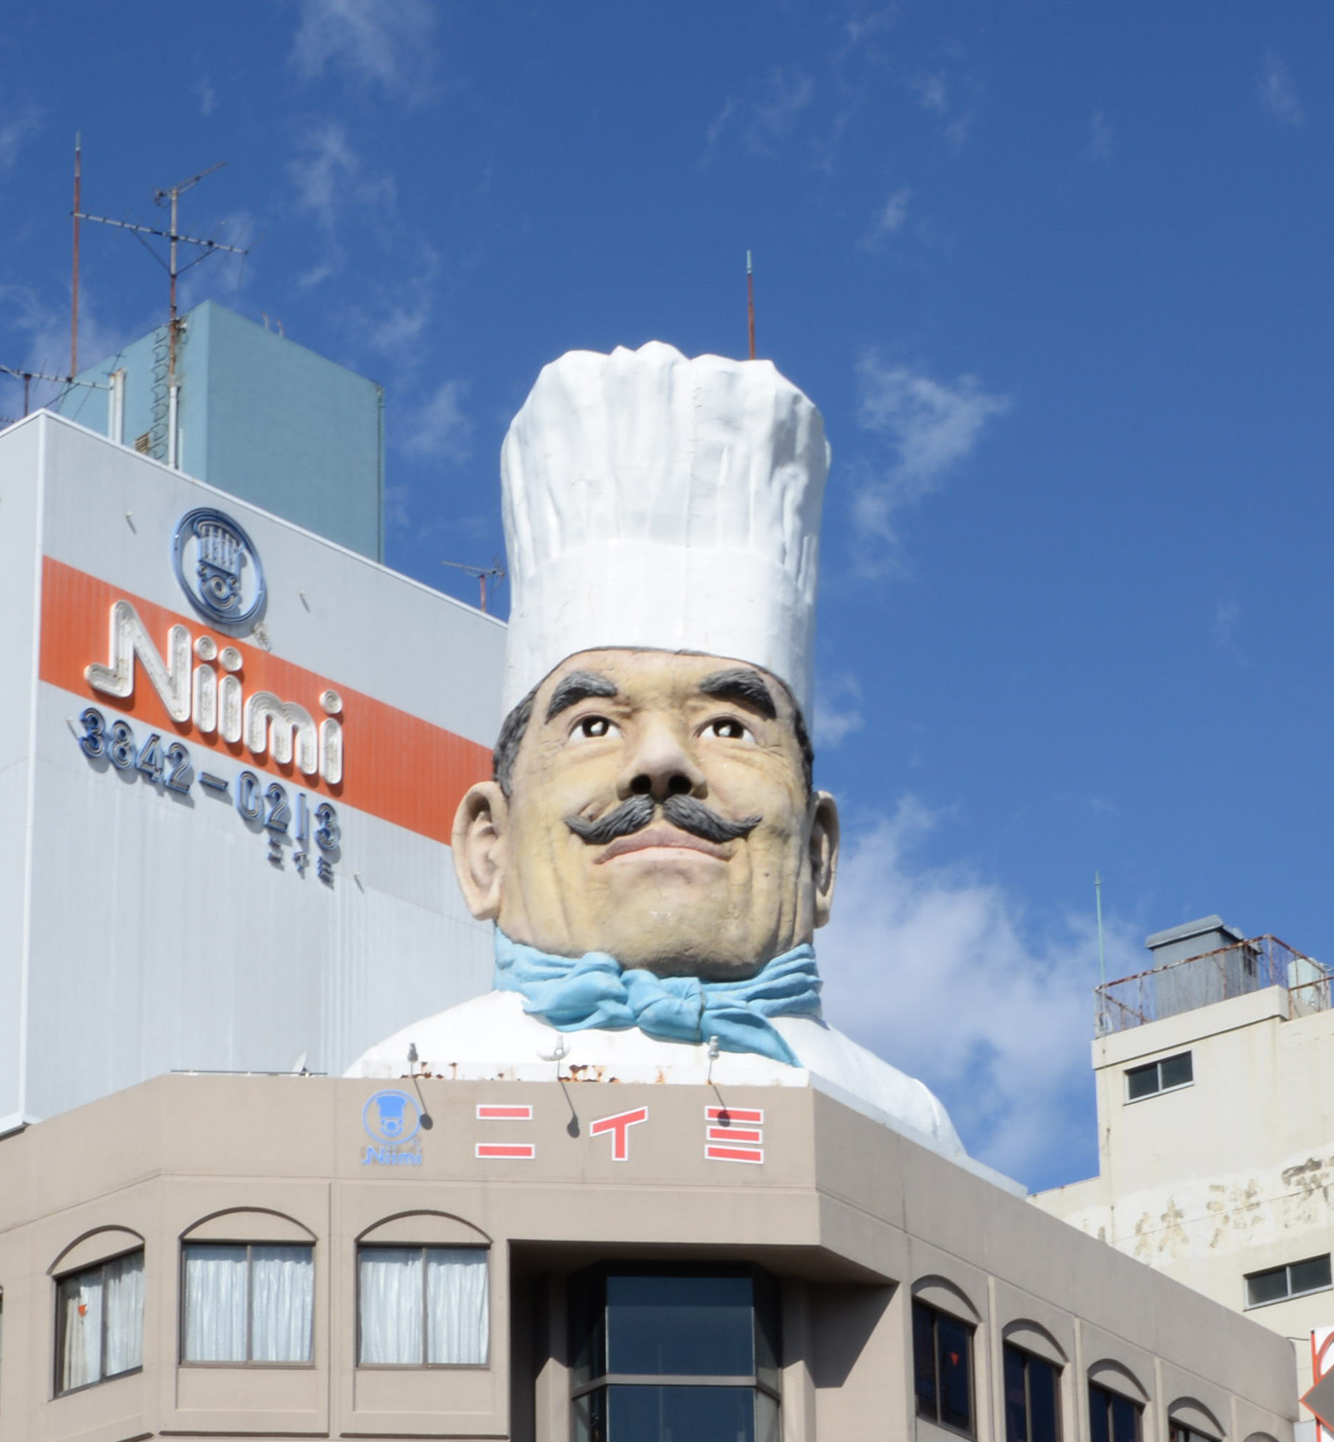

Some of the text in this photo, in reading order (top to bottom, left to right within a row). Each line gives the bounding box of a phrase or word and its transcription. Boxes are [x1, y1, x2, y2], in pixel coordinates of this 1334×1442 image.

[83, 600, 343, 785] Niimi
[79, 707, 341, 851] 3842-0213
[361, 1145, 422, 1166] Niimi
[475, 1104, 764, 1165] ニイミ
